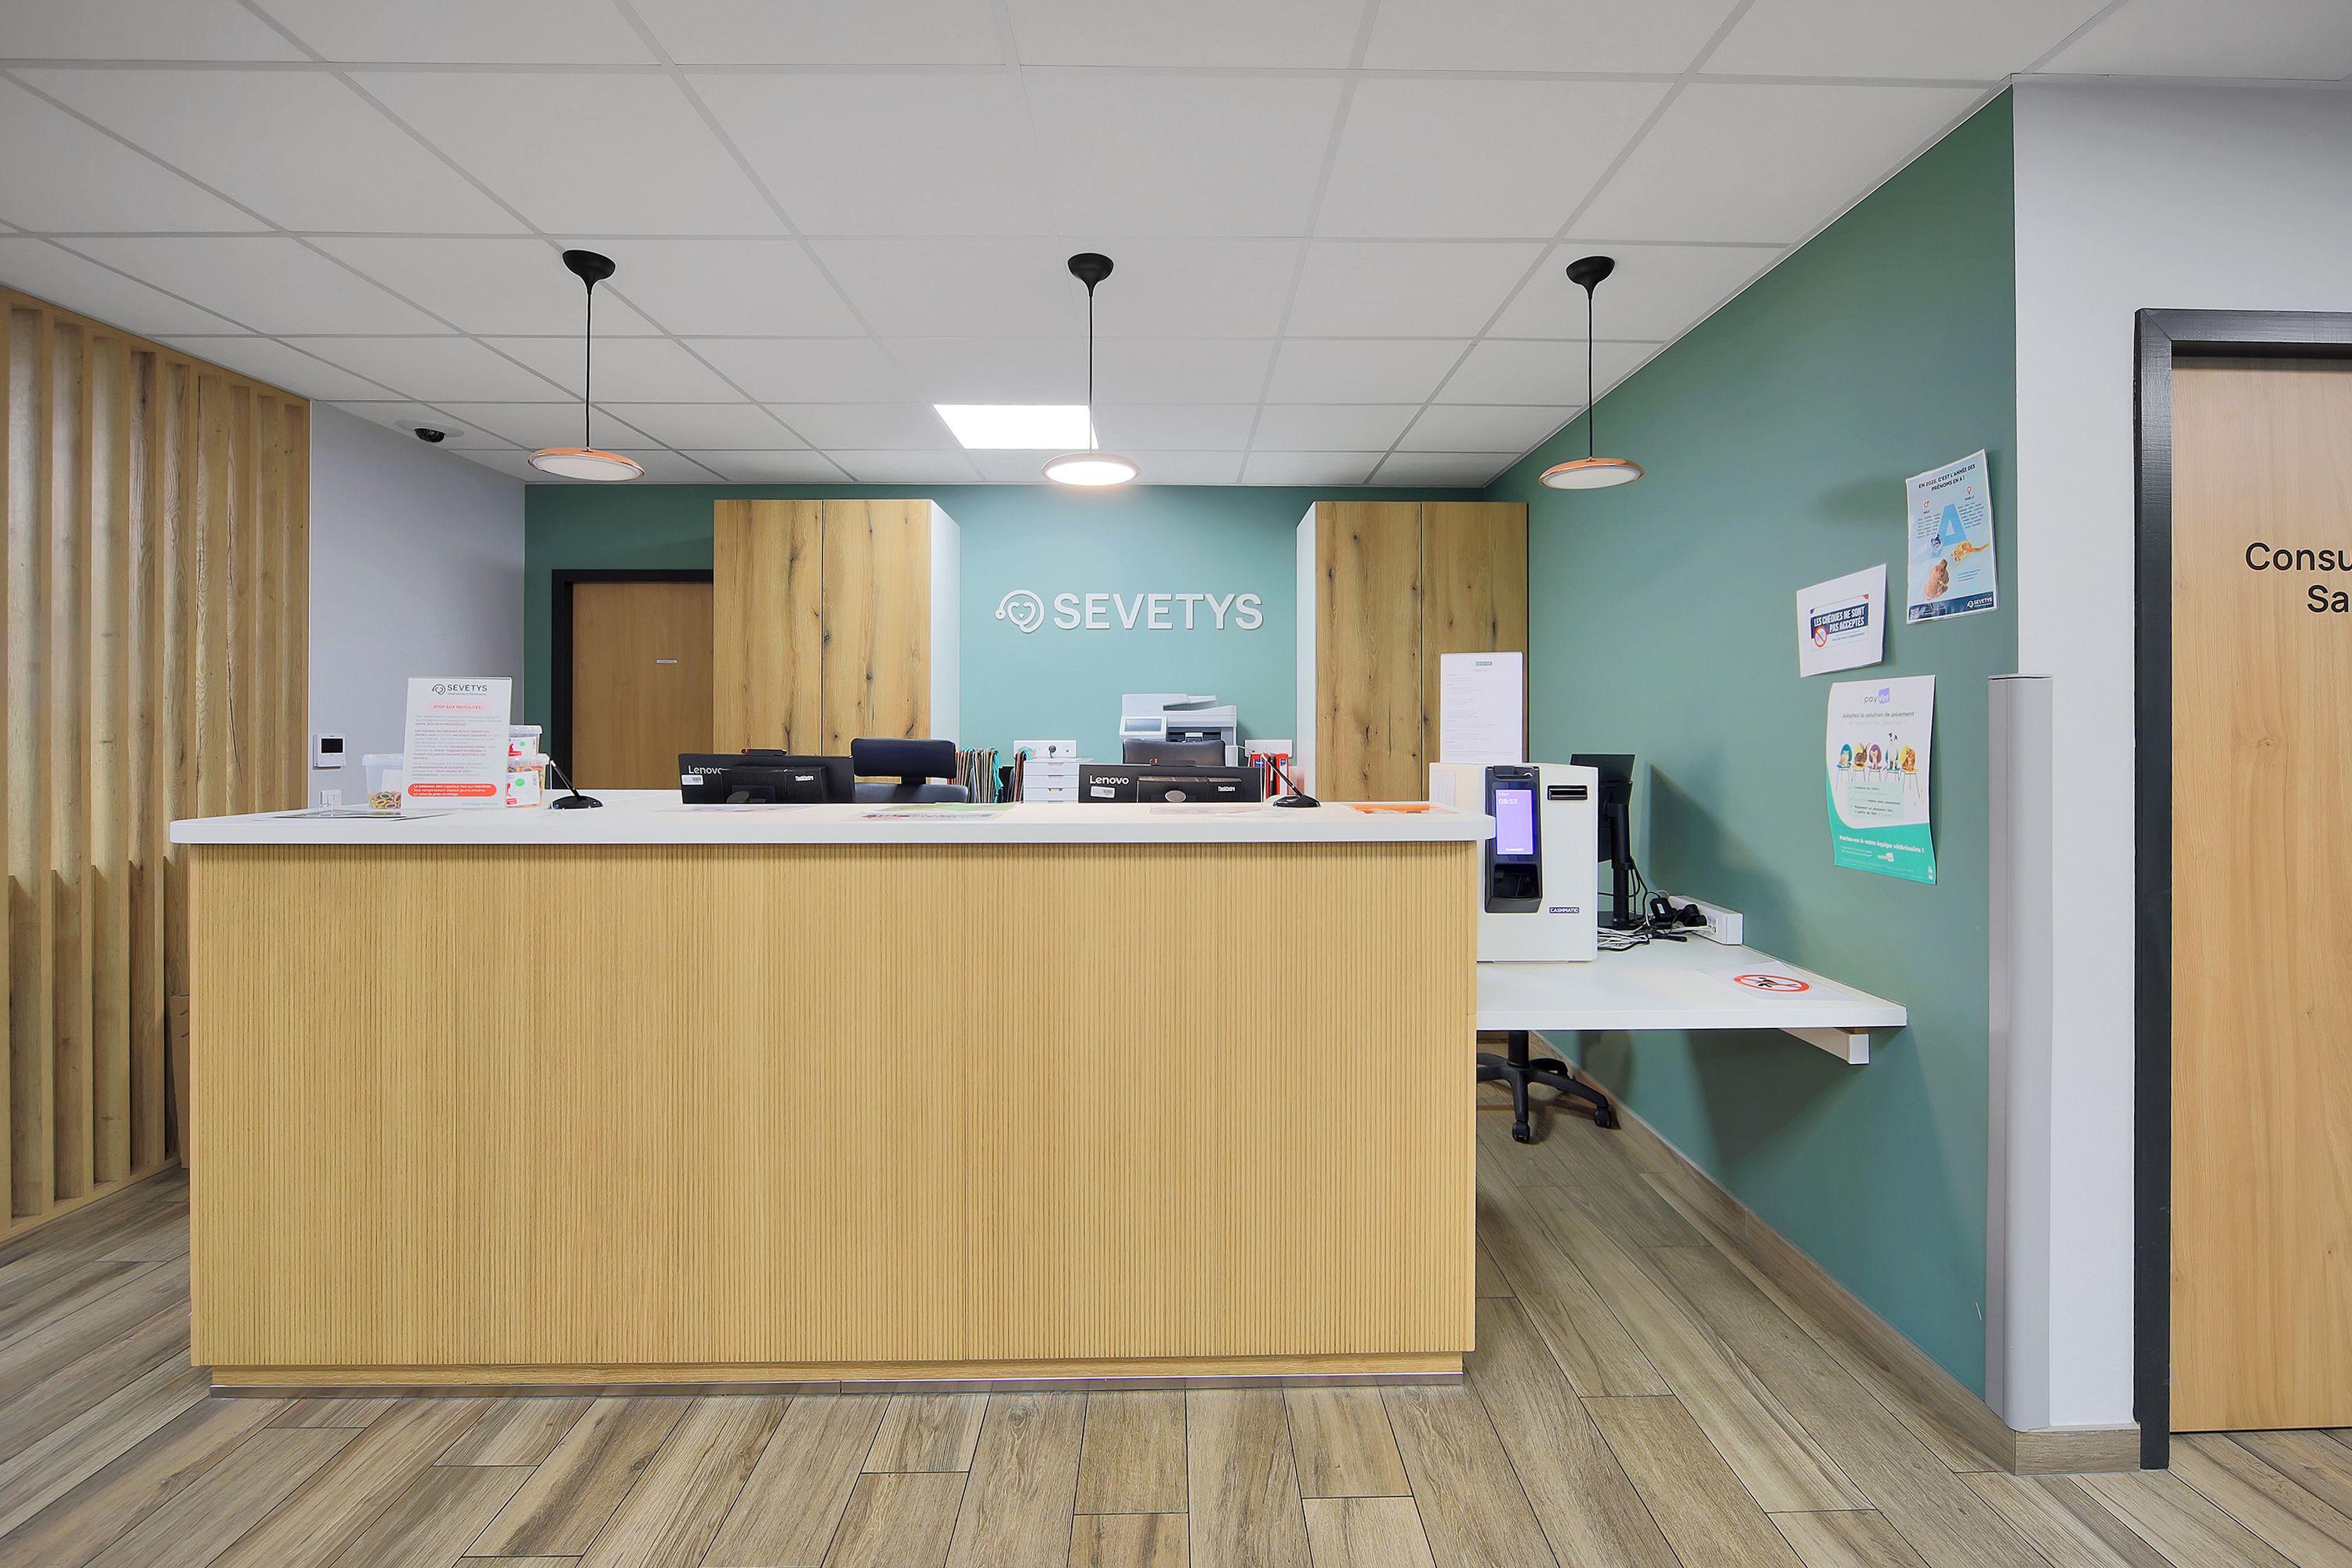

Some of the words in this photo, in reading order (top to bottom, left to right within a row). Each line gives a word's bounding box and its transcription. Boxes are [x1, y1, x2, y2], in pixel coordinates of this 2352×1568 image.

[1931, 481, 1952, 492] PRÉNOMS
[2307, 584, 2349, 613] Sa
[1053, 593, 1264, 630] SEVETYS
[1813, 617, 1822, 627] LES
[1844, 610, 1851, 619] NE
[1851, 606, 1865, 618] SONT
[1829, 622, 1838, 633] PAS
[1089, 775, 1130, 785] Lenovo
